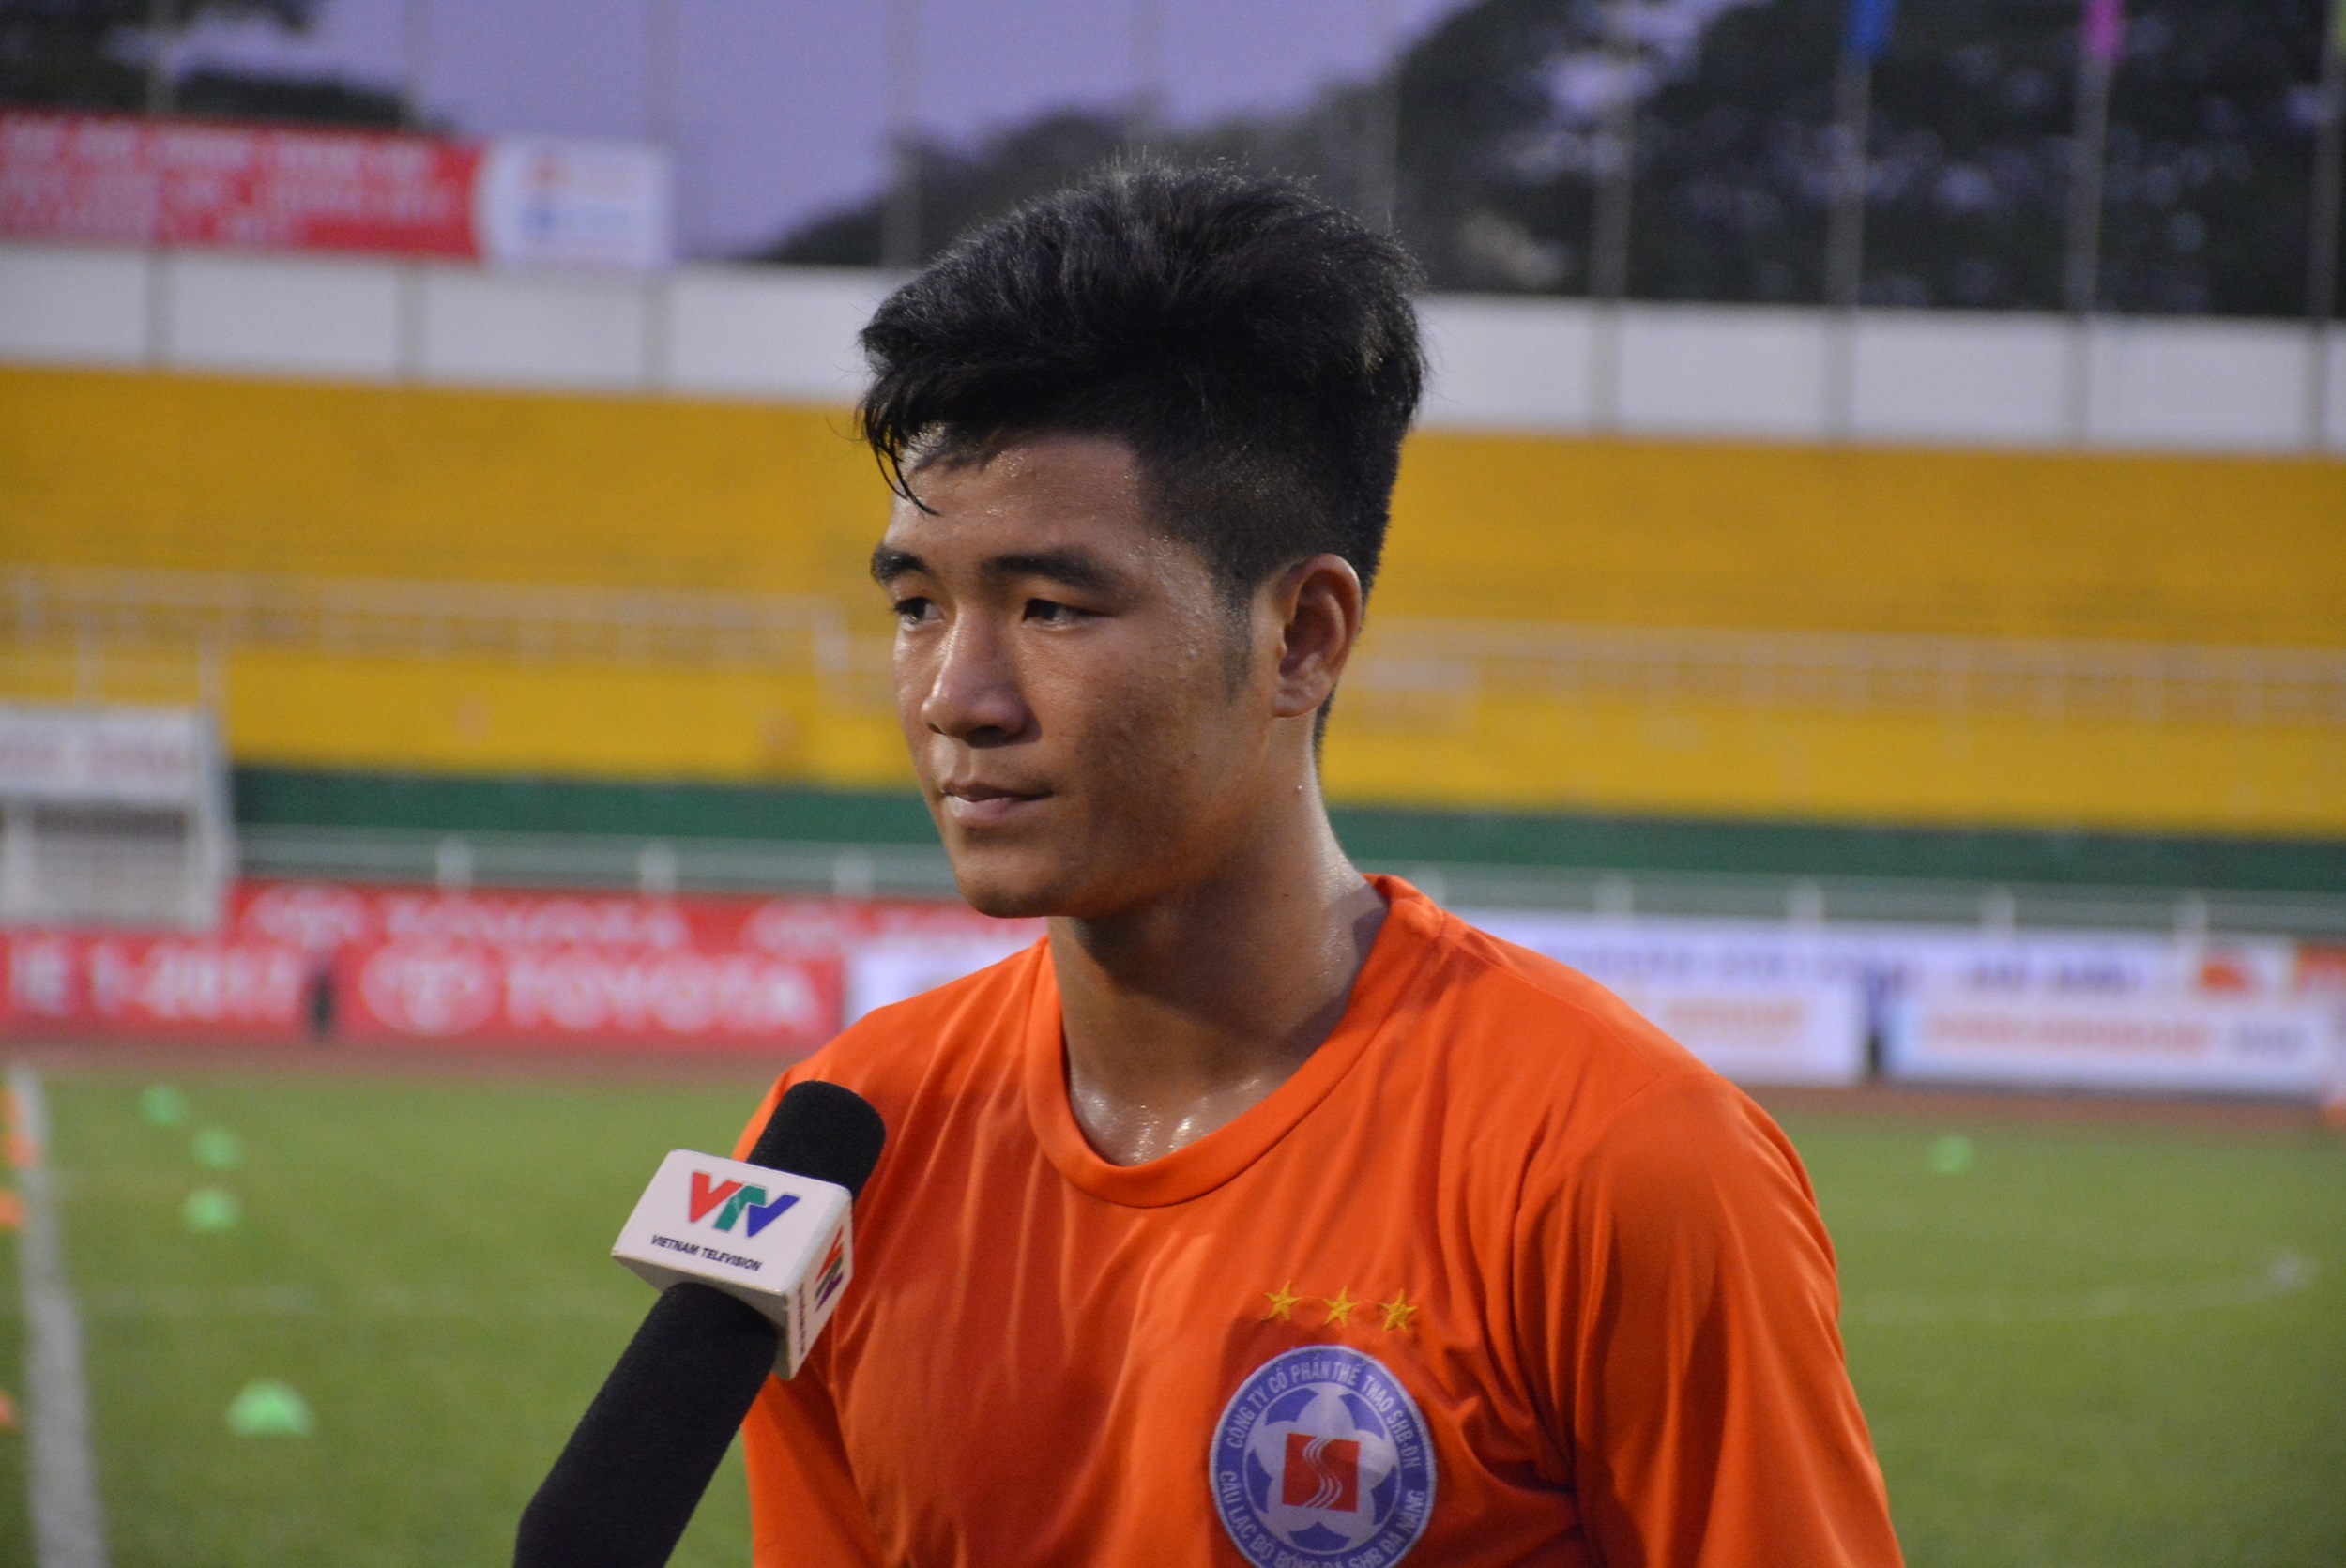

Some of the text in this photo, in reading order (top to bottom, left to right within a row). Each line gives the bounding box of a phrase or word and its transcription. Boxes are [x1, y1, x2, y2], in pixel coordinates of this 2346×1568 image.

[504, 952, 824, 1035] TOYOTA
[689, 1170, 801, 1240] VTV
[650, 1234, 763, 1272] VIETNAM TELEVISION
[1226, 1406, 1257, 1448] CÔNG
[1246, 1385, 1270, 1409] TY
[1361, 1374, 1395, 1413] THAO
